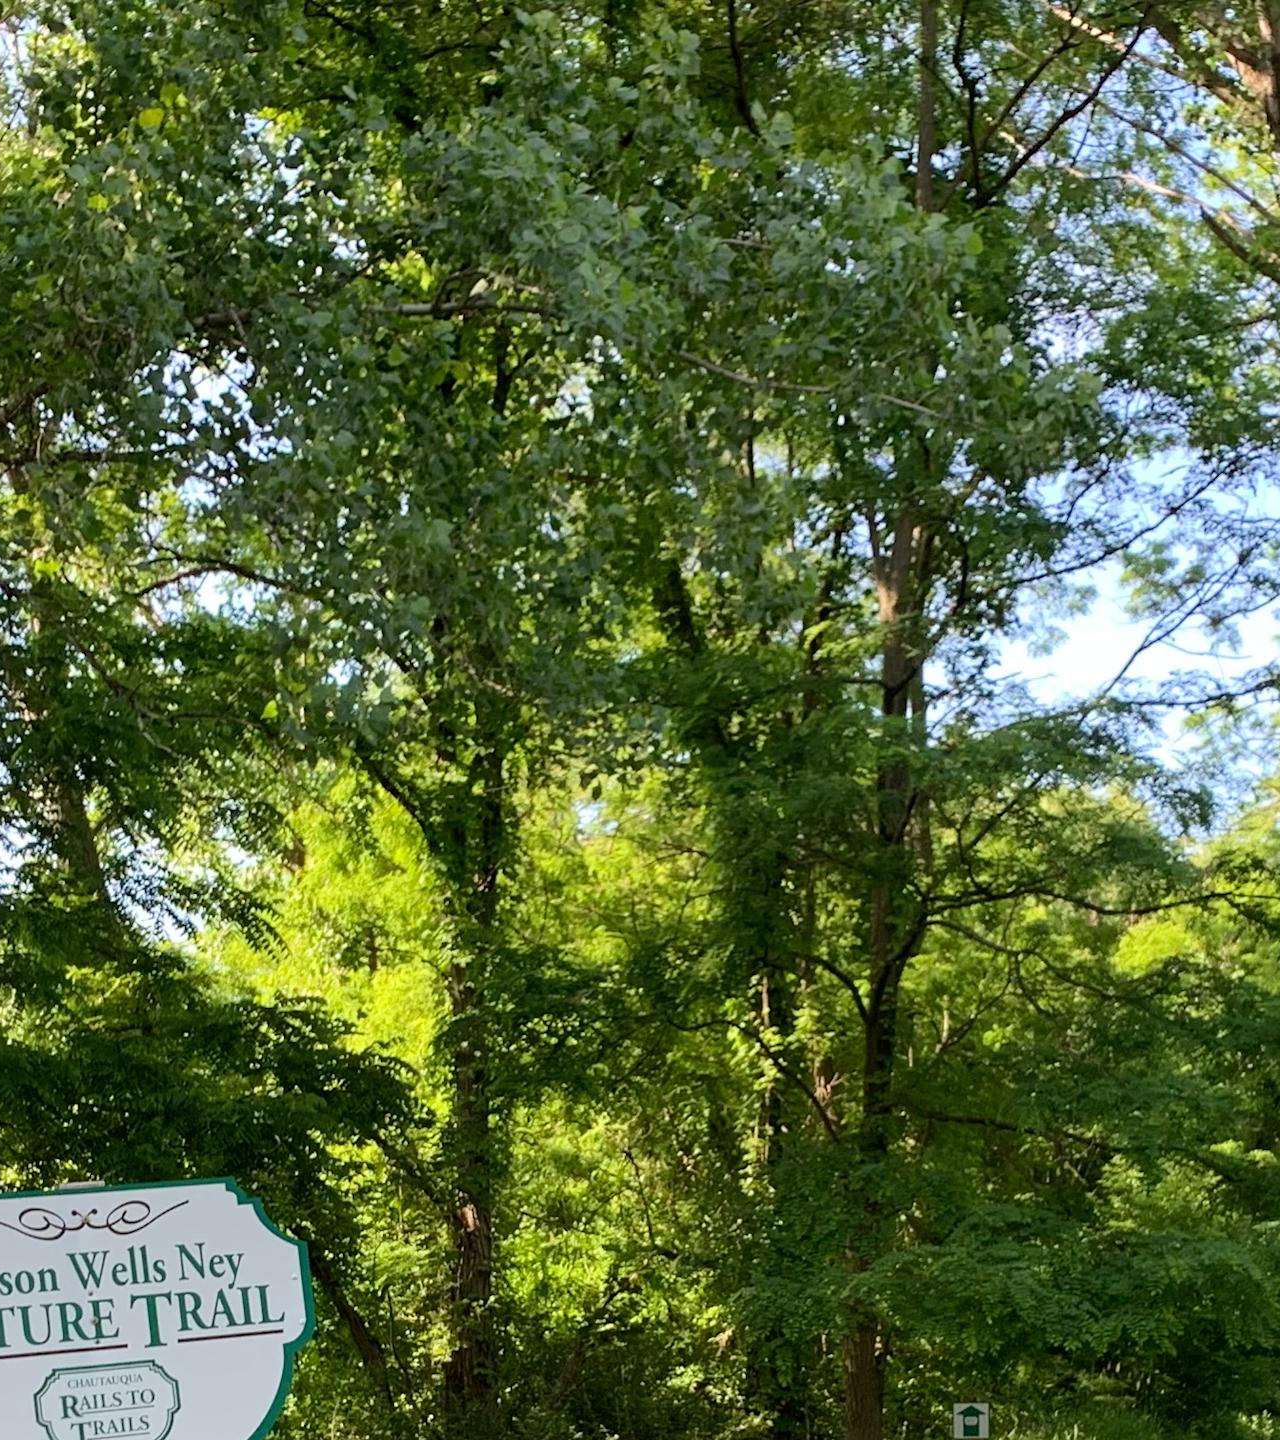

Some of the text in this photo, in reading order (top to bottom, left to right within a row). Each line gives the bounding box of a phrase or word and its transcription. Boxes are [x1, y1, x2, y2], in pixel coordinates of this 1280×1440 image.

[66, 1245, 167, 1290] Wells
[175, 1242, 245, 1289] Ney
[130, 1284, 286, 1348] TRAIL
[67, 1373, 144, 1389] CHAUTAUQUA
[59, 1388, 155, 1419] RAILS TO
